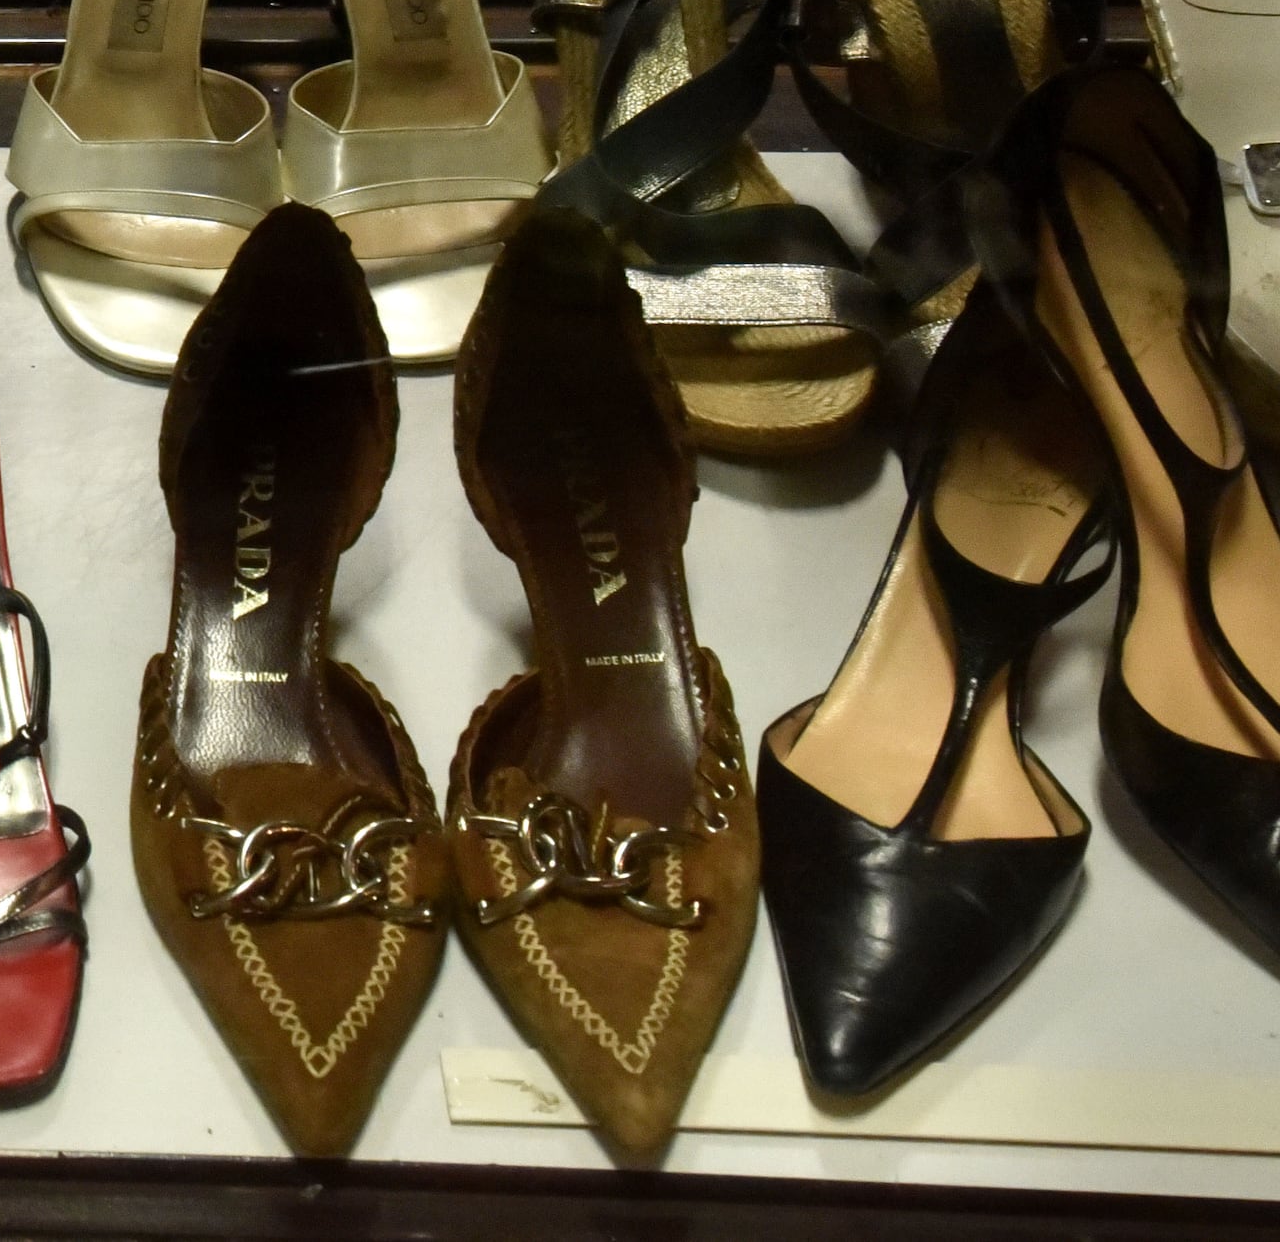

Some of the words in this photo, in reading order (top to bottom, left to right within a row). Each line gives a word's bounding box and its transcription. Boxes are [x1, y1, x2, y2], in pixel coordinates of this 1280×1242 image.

[586, 655, 619, 667] MADE
[621, 654, 633, 665] IN
[634, 652, 665, 664] ITALY
[244, 672, 258, 682] IN
[259, 672, 289, 683] ITALY
